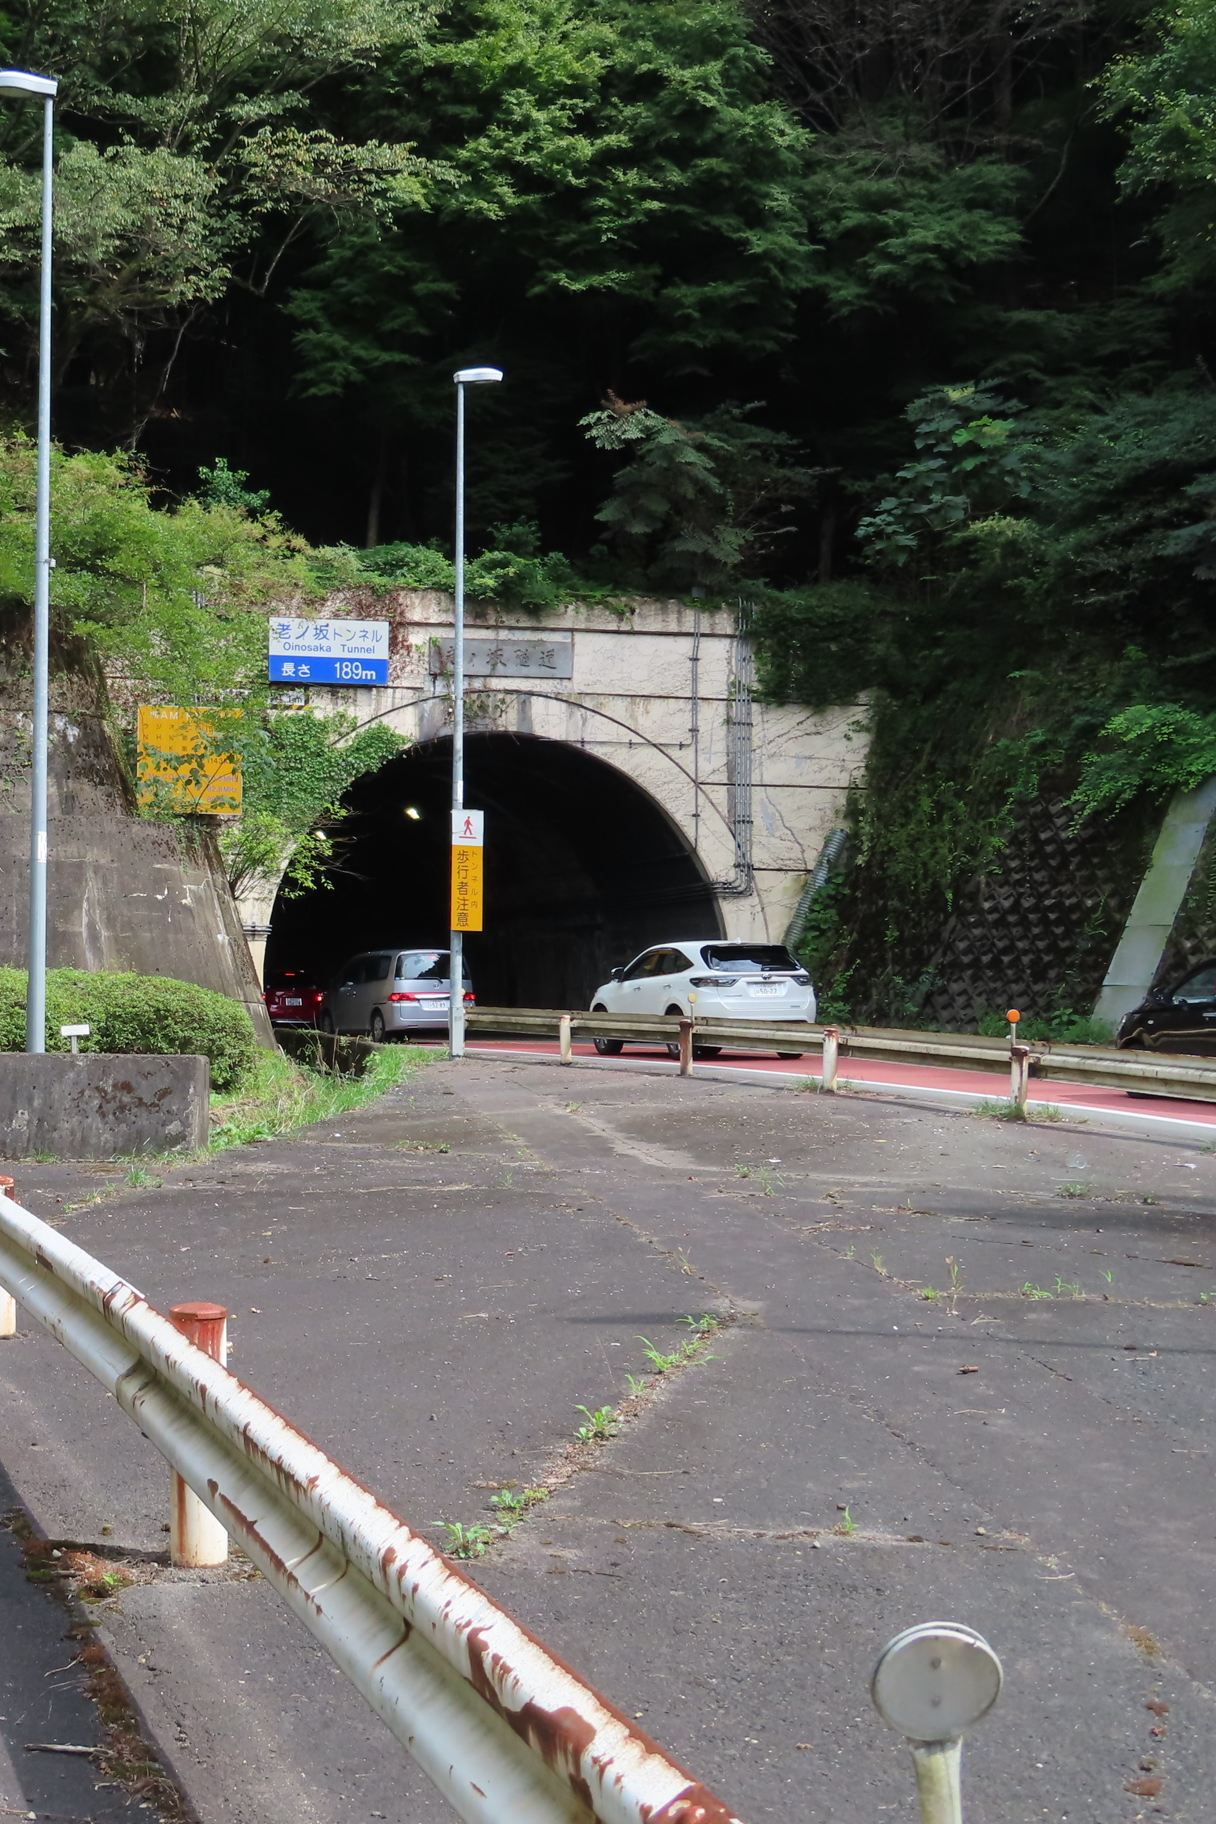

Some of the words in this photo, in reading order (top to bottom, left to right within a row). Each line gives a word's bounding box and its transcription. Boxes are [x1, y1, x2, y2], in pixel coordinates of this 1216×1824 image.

[275, 622, 383, 644] 老ノ坂トンネル
[283, 642, 332, 653] Oinosaka
[340, 643, 375, 654] Tunnel
[281, 662, 311, 678] 長さ
[334, 661, 377, 680] 189m
[457, 850, 469, 927] 歩行者注意
